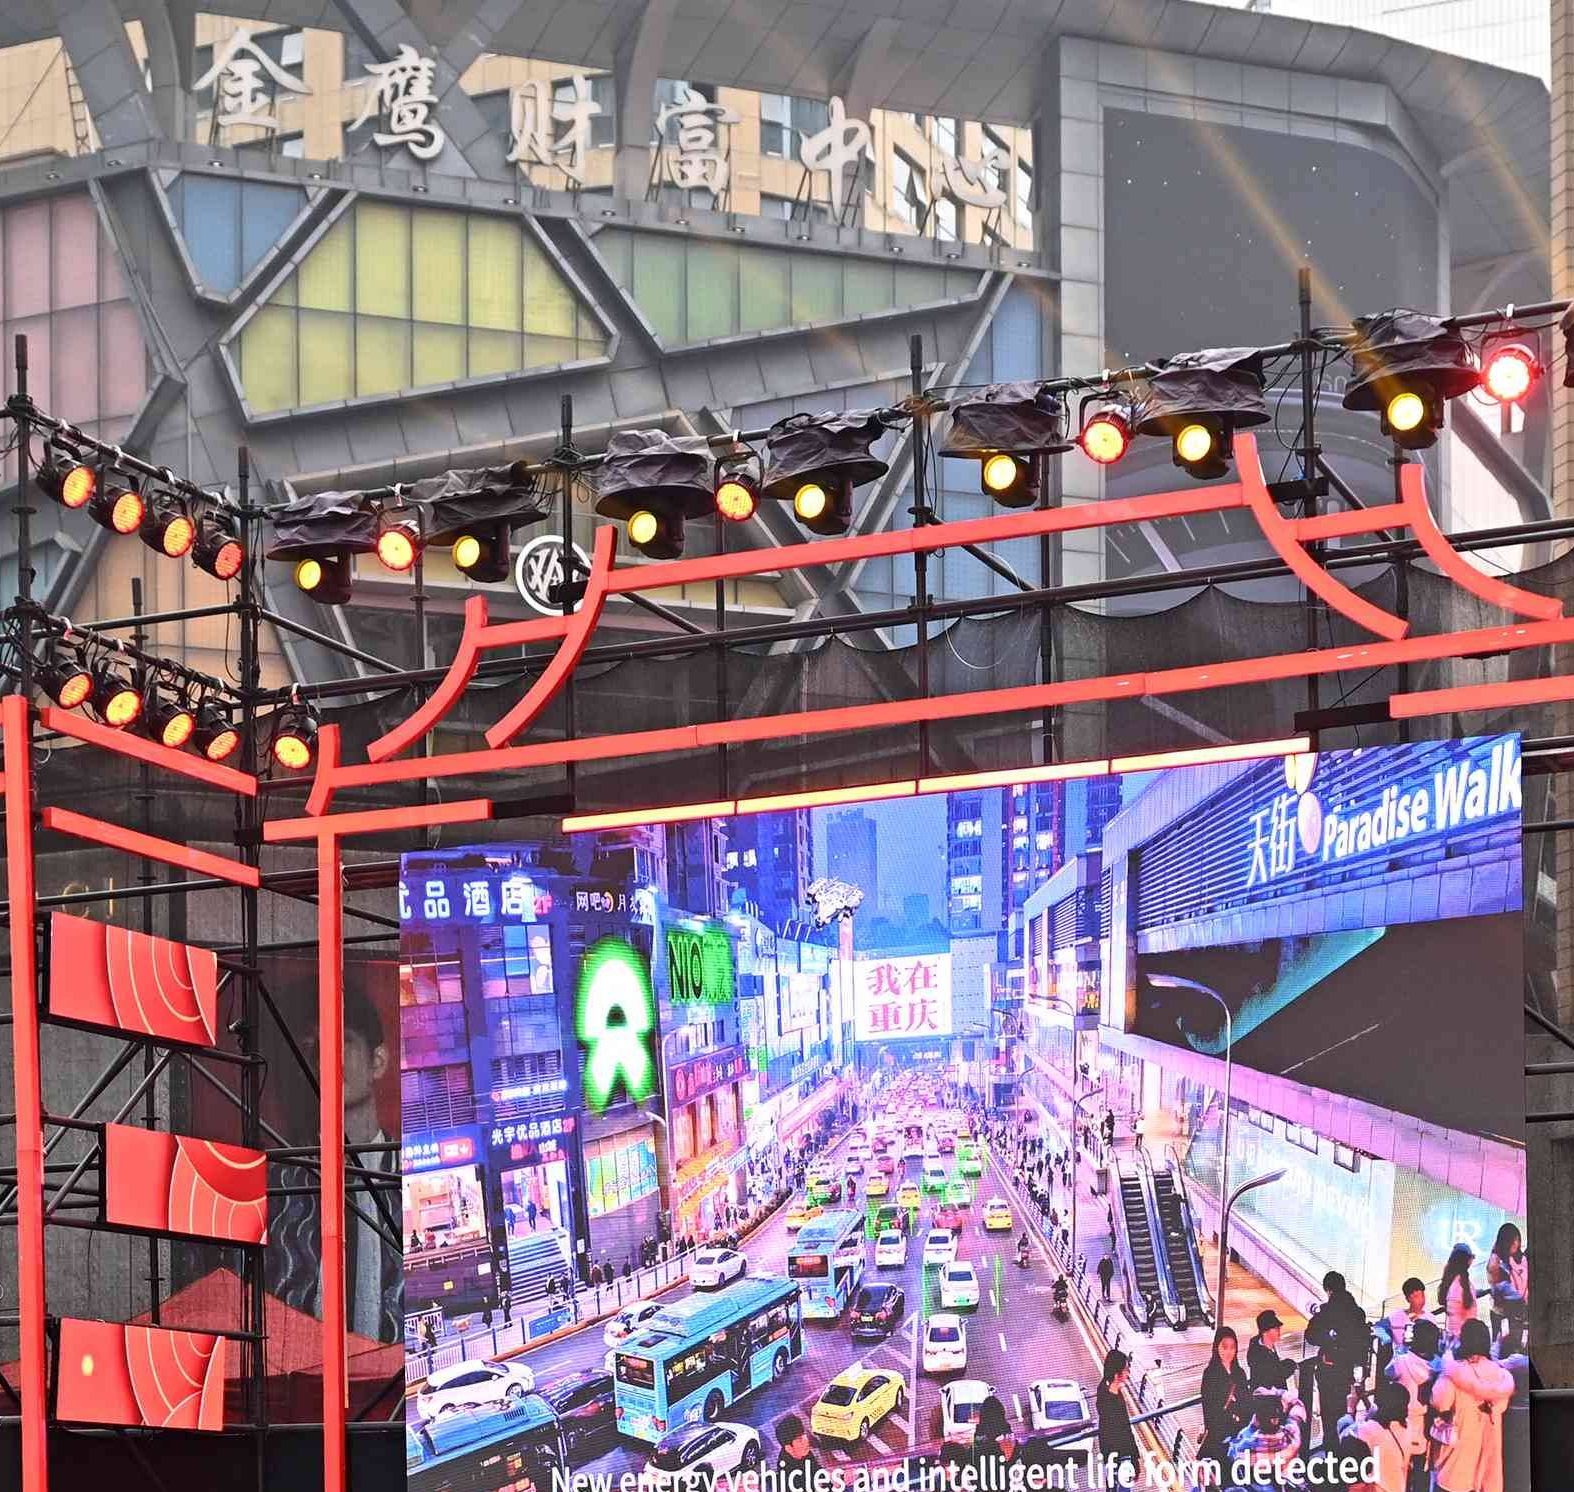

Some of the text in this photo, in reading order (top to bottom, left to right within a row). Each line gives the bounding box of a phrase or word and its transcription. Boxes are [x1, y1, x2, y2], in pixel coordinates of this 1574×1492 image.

[194, 27, 1012, 227] 金鹰财富中心
[1247, 739, 1522, 888] 天街 Paradise Walk
[668, 932, 703, 1000] NIO
[867, 960, 938, 997] 我在
[868, 998, 938, 1034] 重庆
[853, 1457, 910, 1492] and
[1086, 1454, 1136, 1489] life
[1143, 1452, 1221, 1487] form
[1230, 1447, 1381, 1486] detected
